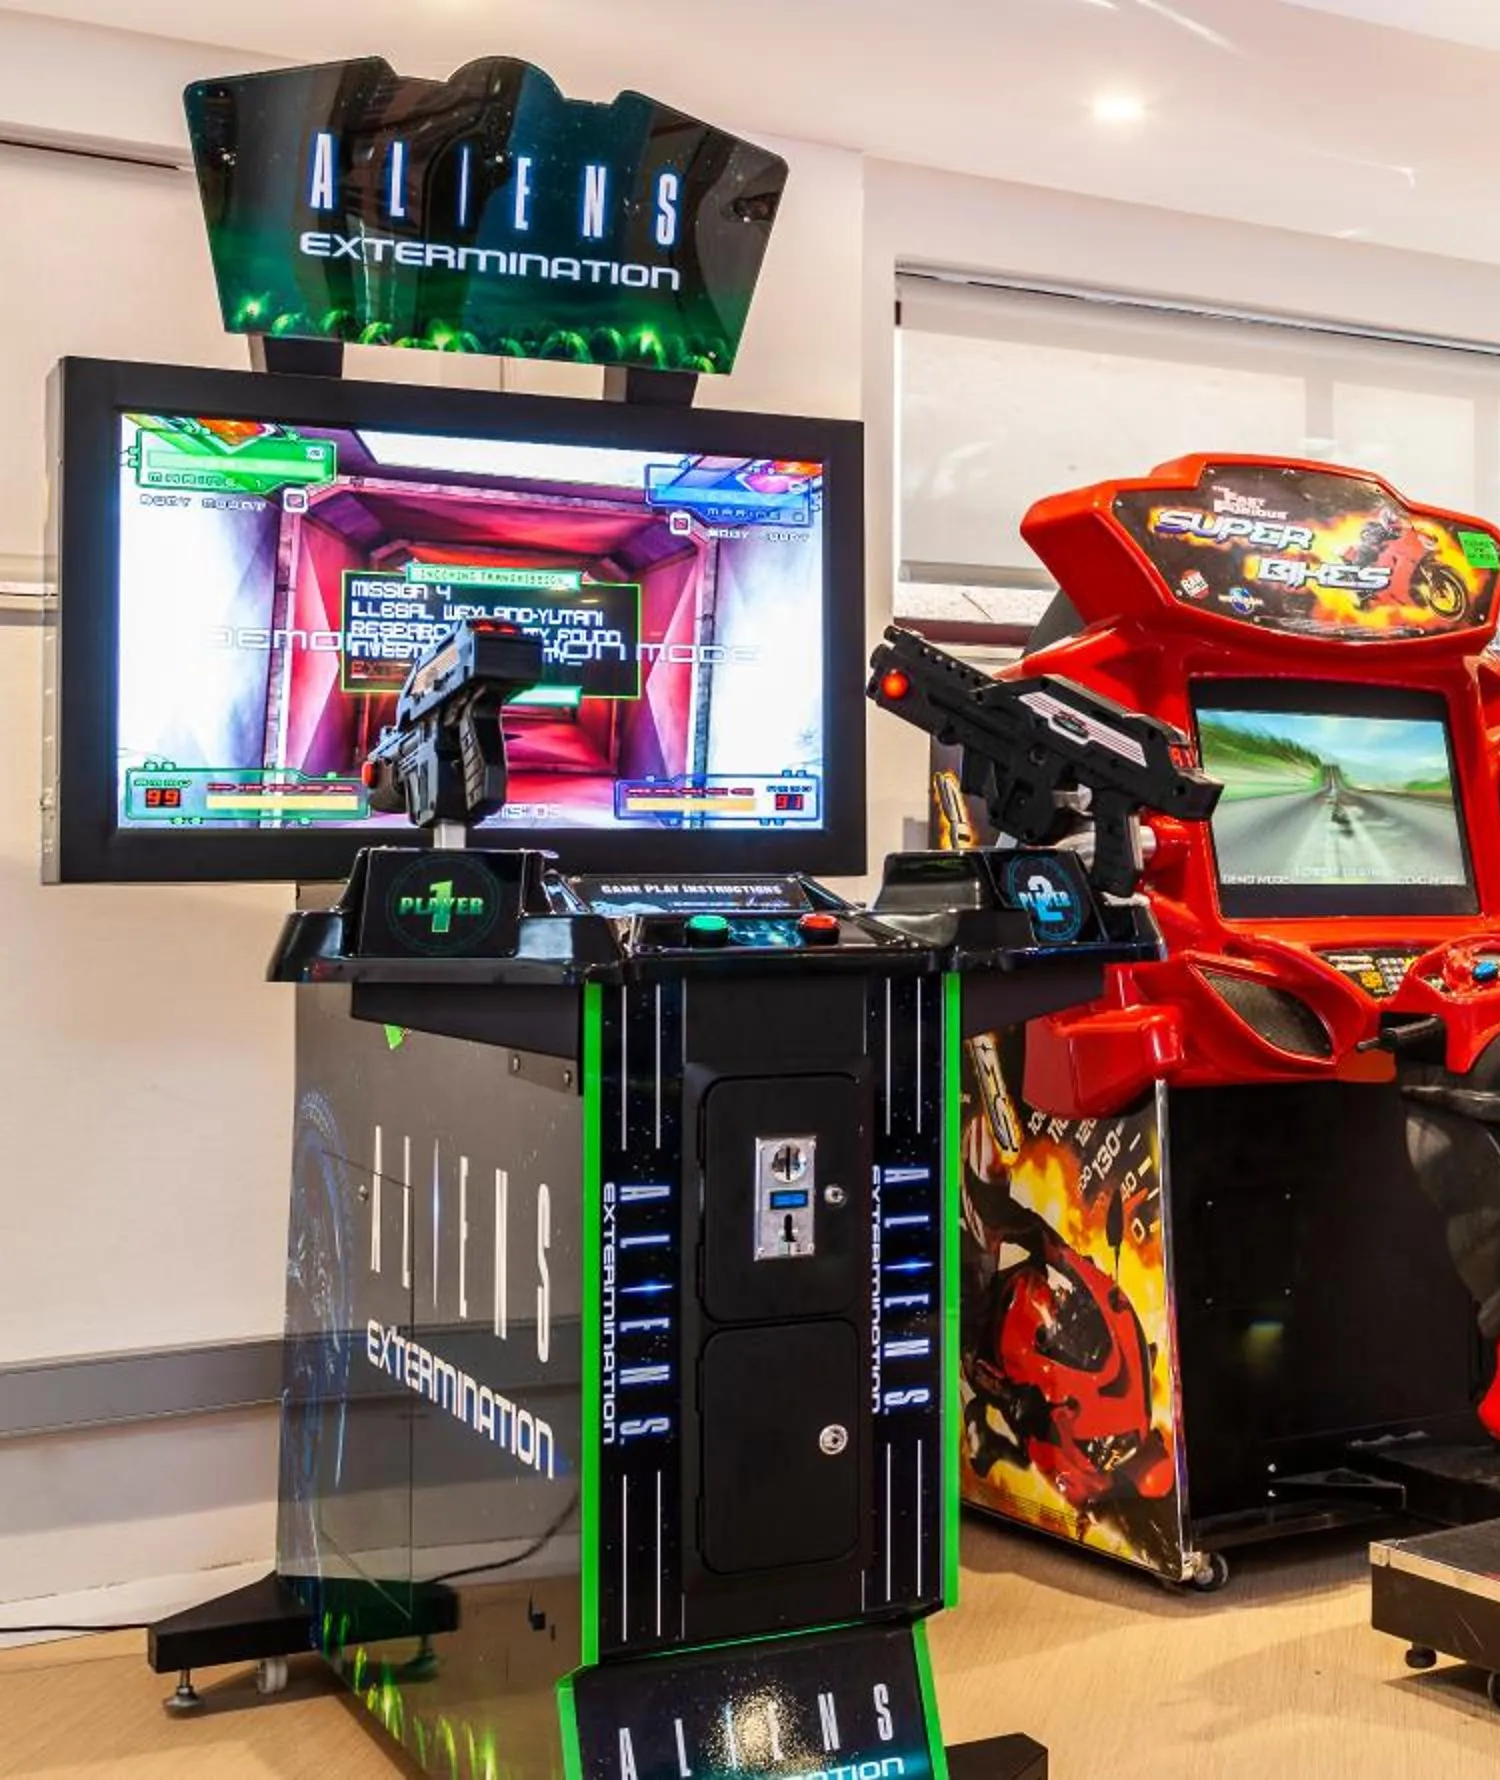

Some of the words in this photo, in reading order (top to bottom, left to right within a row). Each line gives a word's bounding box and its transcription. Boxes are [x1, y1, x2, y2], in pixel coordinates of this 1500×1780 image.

[310, 132, 680, 248] ALIENS
[299, 231, 681, 291] EXTERMINATION
[1155, 508, 1316, 551] SUPER
[351, 580, 428, 600] MISSION
[436, 583, 451, 600] 4
[1257, 556, 1393, 590] BIKES
[351, 600, 434, 620] ILLEGAL
[351, 619, 450, 641] RESEARC
[429, 879, 454, 933] 1
[601, 884, 643, 895] GAME
[644, 884, 679, 895] PLAY
[682, 884, 783, 895] INSTRUCTIONS
[1027, 875, 1065, 922] 2
[1091, 1129, 1121, 1181] 130
[370, 1125, 551, 1364] ALIENS
[602, 1181, 617, 1446] EXTERMINATION
[619, 1182, 674, 1436] ALIENS
[883, 1167, 933, 1410] ALIENS
[366, 1318, 555, 1481] EXTERMINATION
